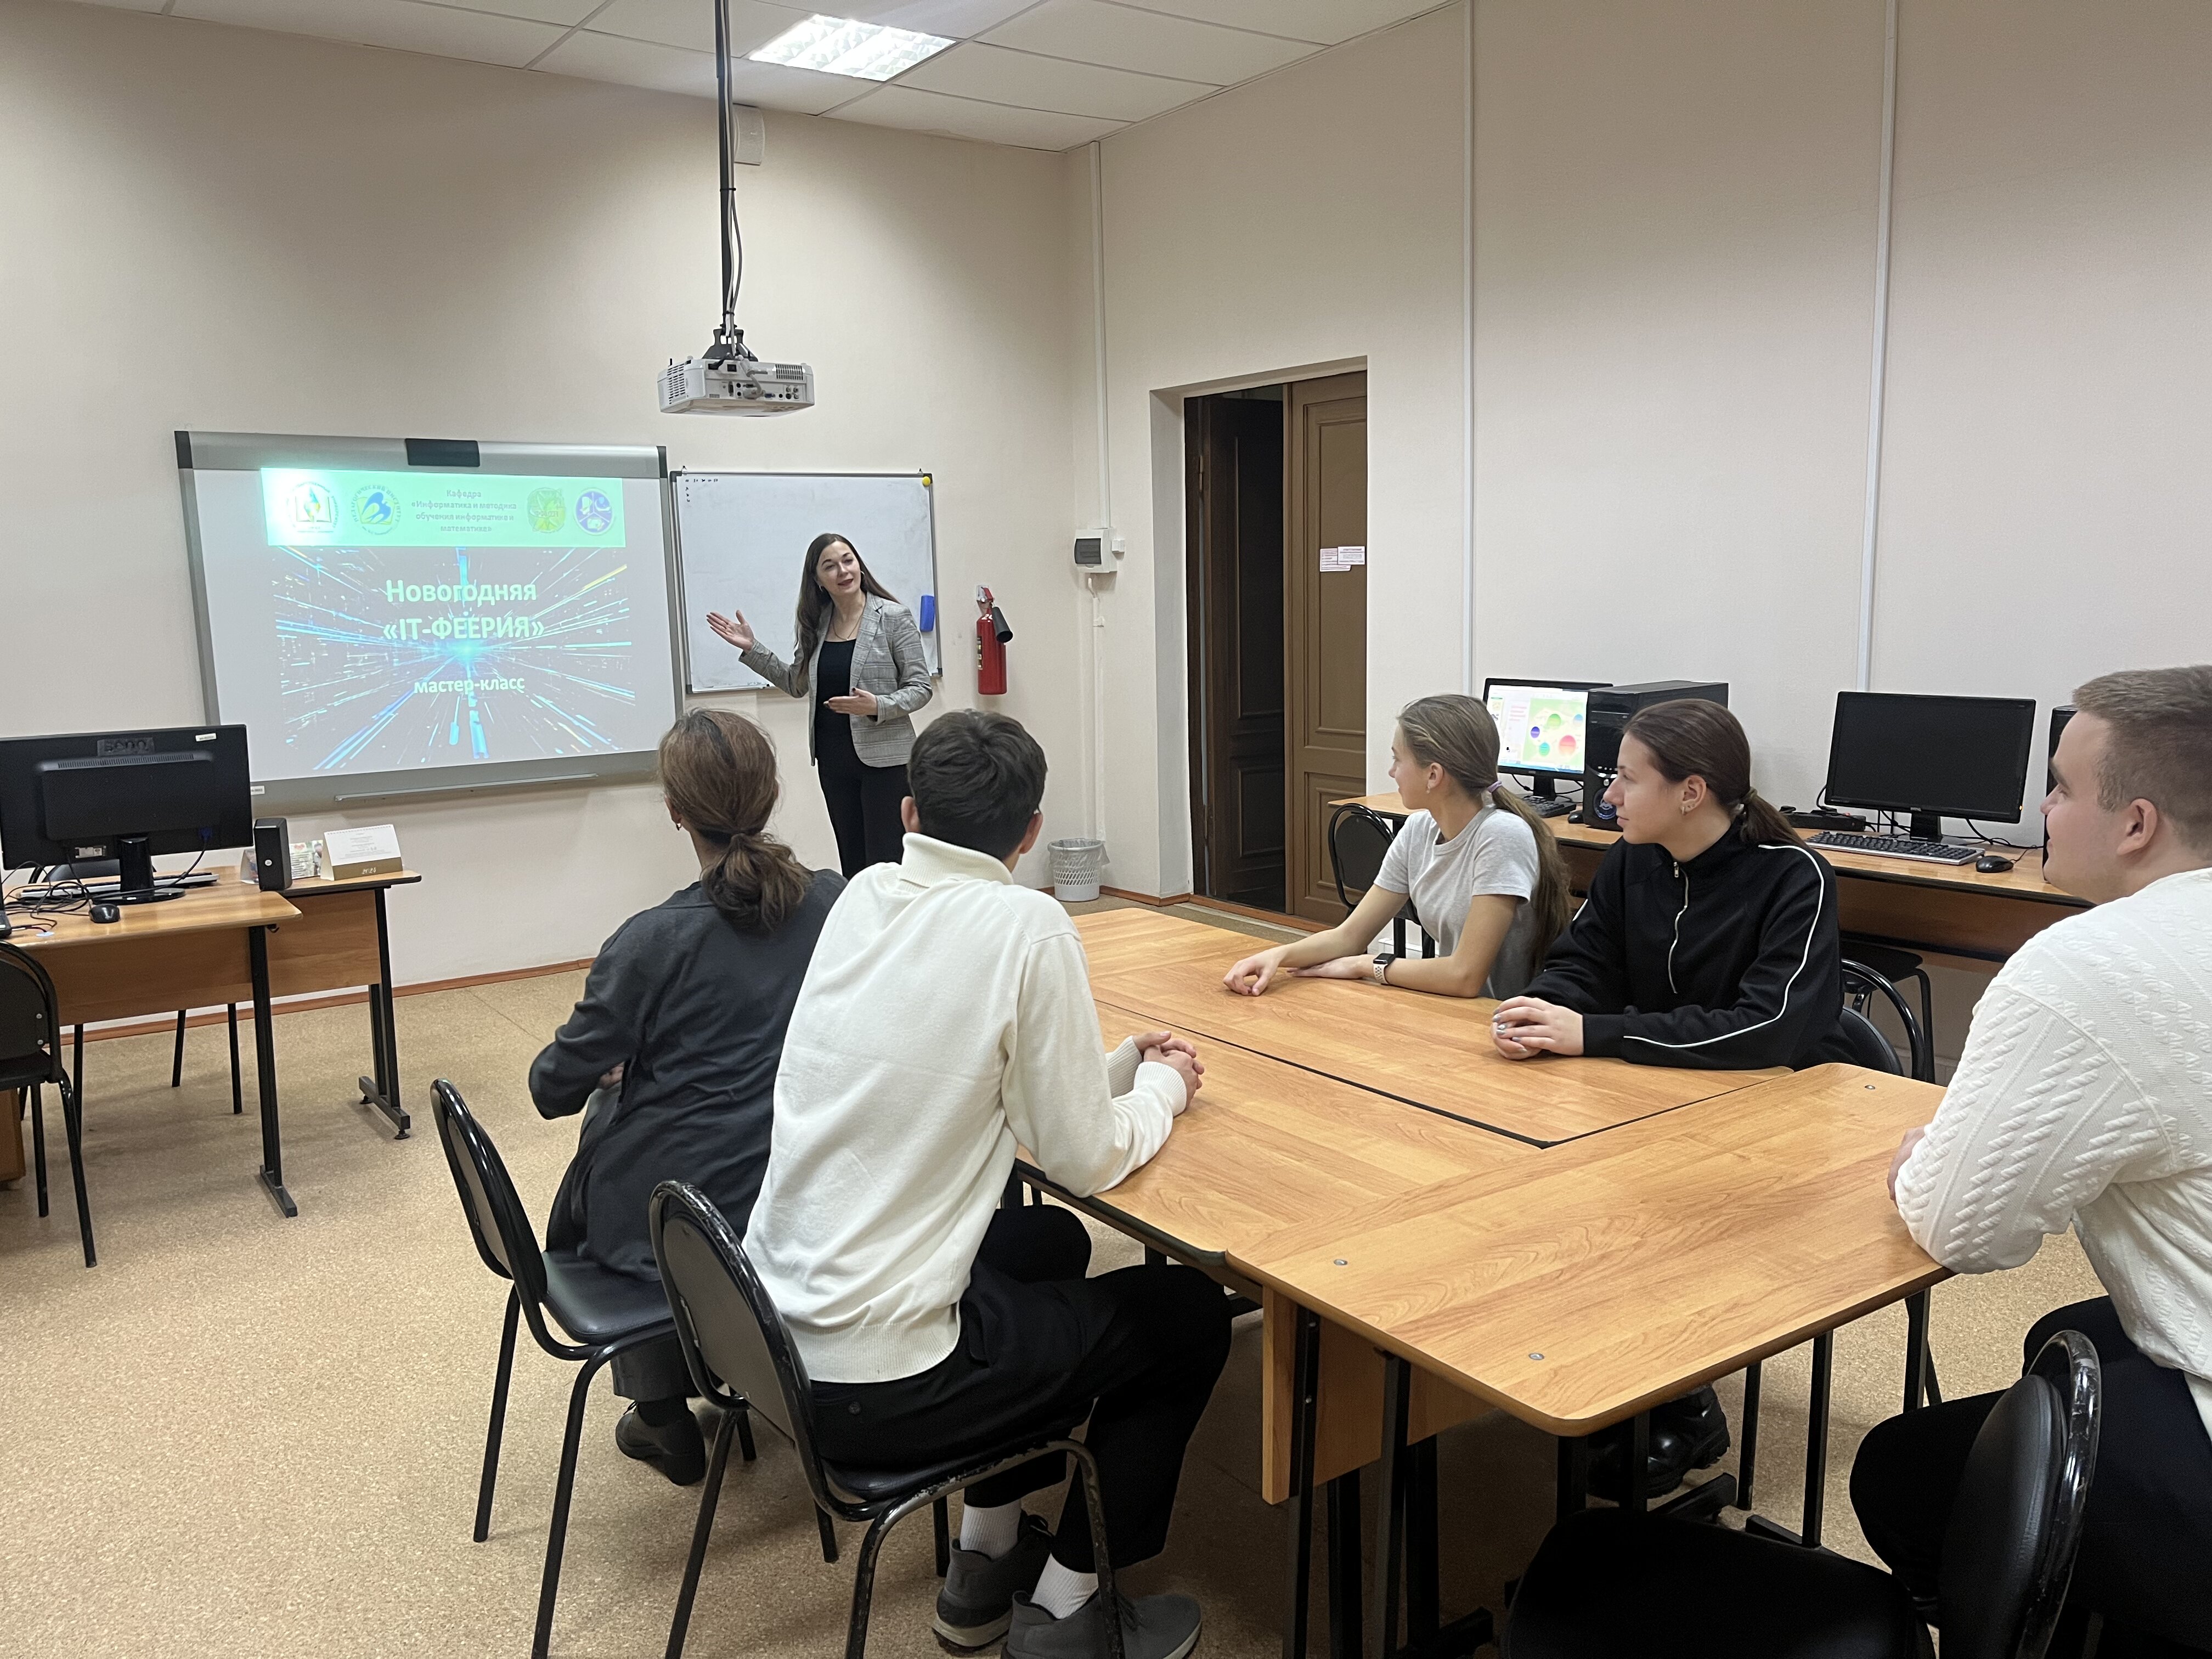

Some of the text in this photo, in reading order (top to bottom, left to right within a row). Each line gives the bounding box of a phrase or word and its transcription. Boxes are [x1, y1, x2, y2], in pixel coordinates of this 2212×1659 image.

[447, 489, 482, 499] Кафедра
[479, 503, 517, 511] методика
[416, 512, 454, 521] обучения
[386, 579, 537, 608] Новогодняя
[383, 616, 545, 641] «IT-ФЕЕРИЯ»
[414, 678, 525, 695] мастер-класс
